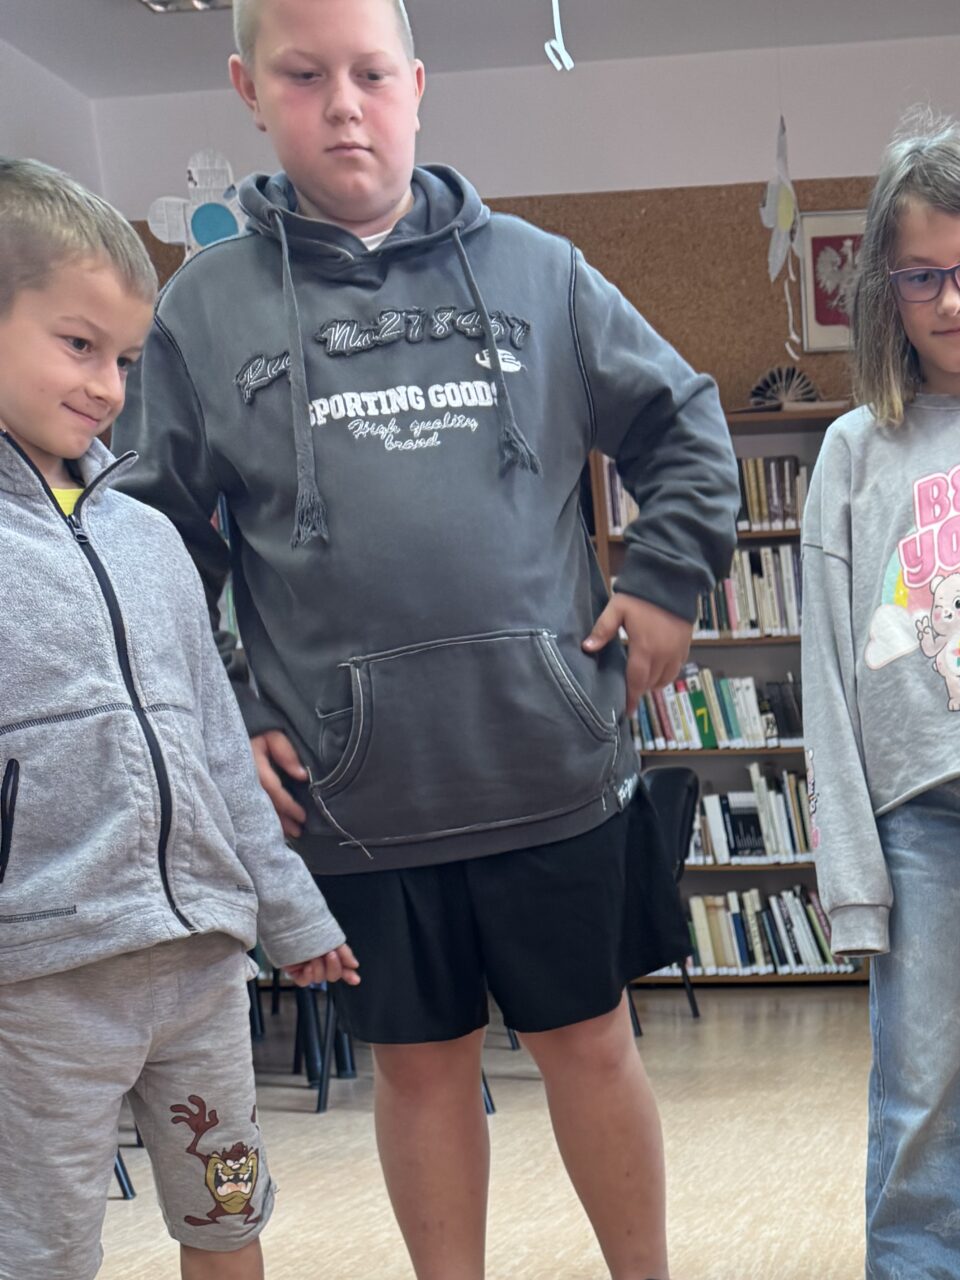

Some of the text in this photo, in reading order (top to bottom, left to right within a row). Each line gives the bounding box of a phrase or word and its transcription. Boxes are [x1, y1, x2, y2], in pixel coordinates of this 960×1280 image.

[348, 411, 479, 440] High quality
[384, 431, 441, 451] brand
